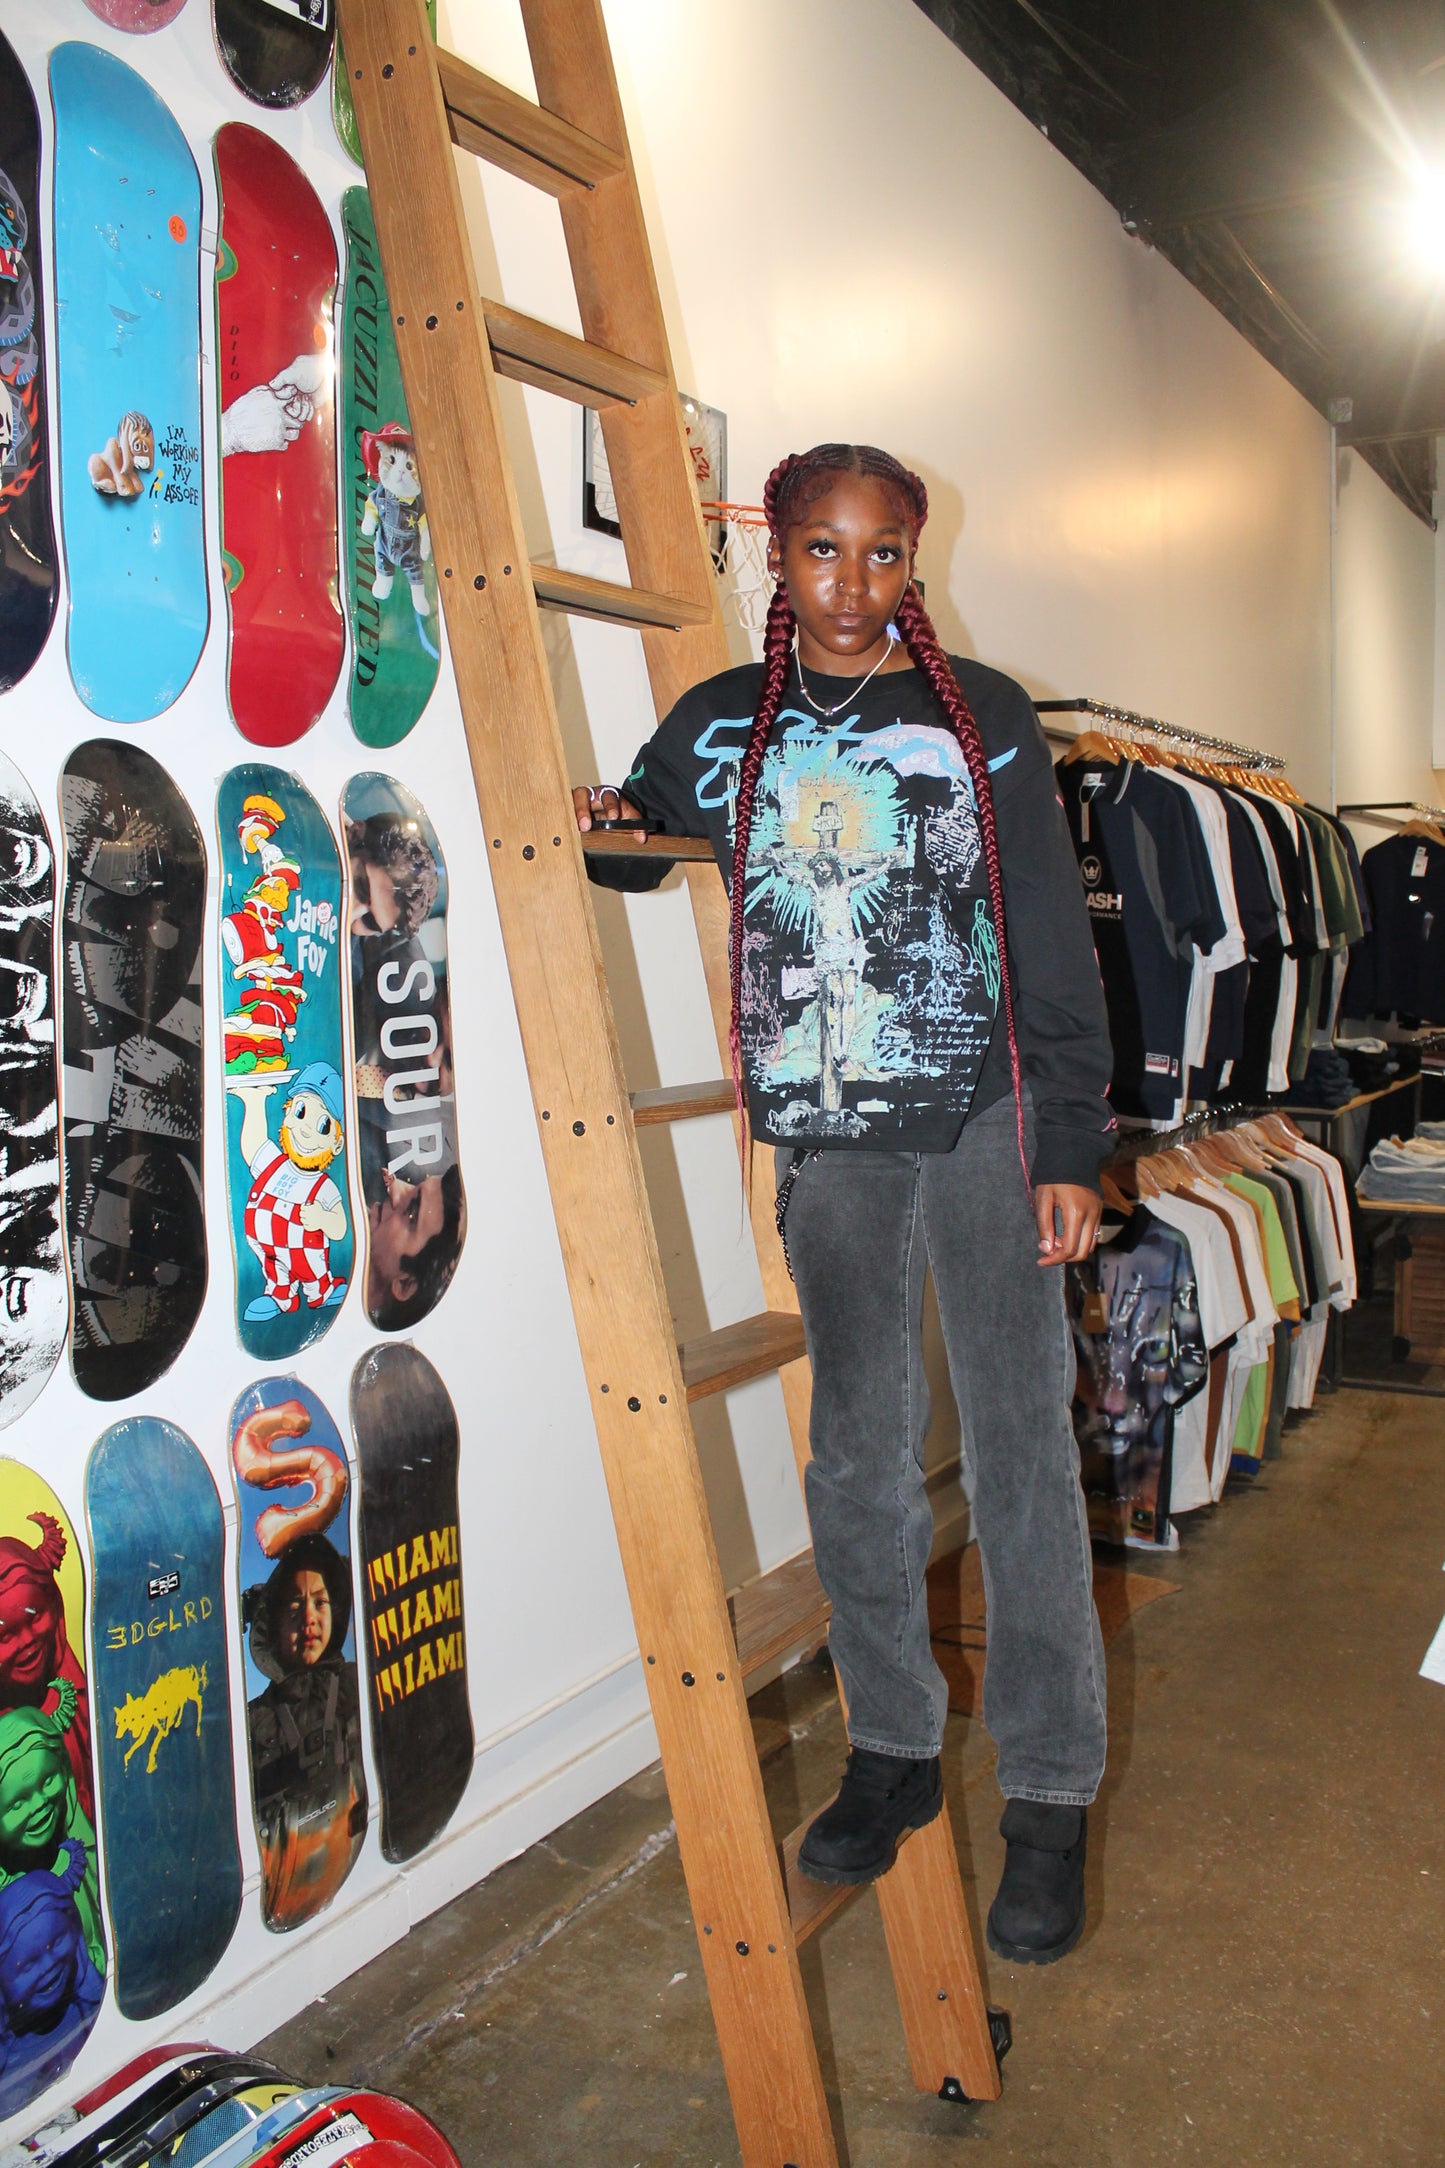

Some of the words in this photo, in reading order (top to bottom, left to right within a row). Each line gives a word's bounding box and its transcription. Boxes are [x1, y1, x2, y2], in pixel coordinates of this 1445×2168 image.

[348, 219, 378, 416] JACUZZI
[167, 425, 187, 442] I'M
[158, 439, 199, 465] WORKING
[173, 464, 192, 486] MY
[164, 484, 184, 504] ASS
[183, 487, 198, 506] OFF
[355, 425, 379, 687] NLMITED
[1087, 892, 1123, 911] ASH
[377, 959, 443, 1175] SOUR
[280, 1173, 298, 1184] BIG
[291, 2123, 355, 2166] SKATEBOARD
